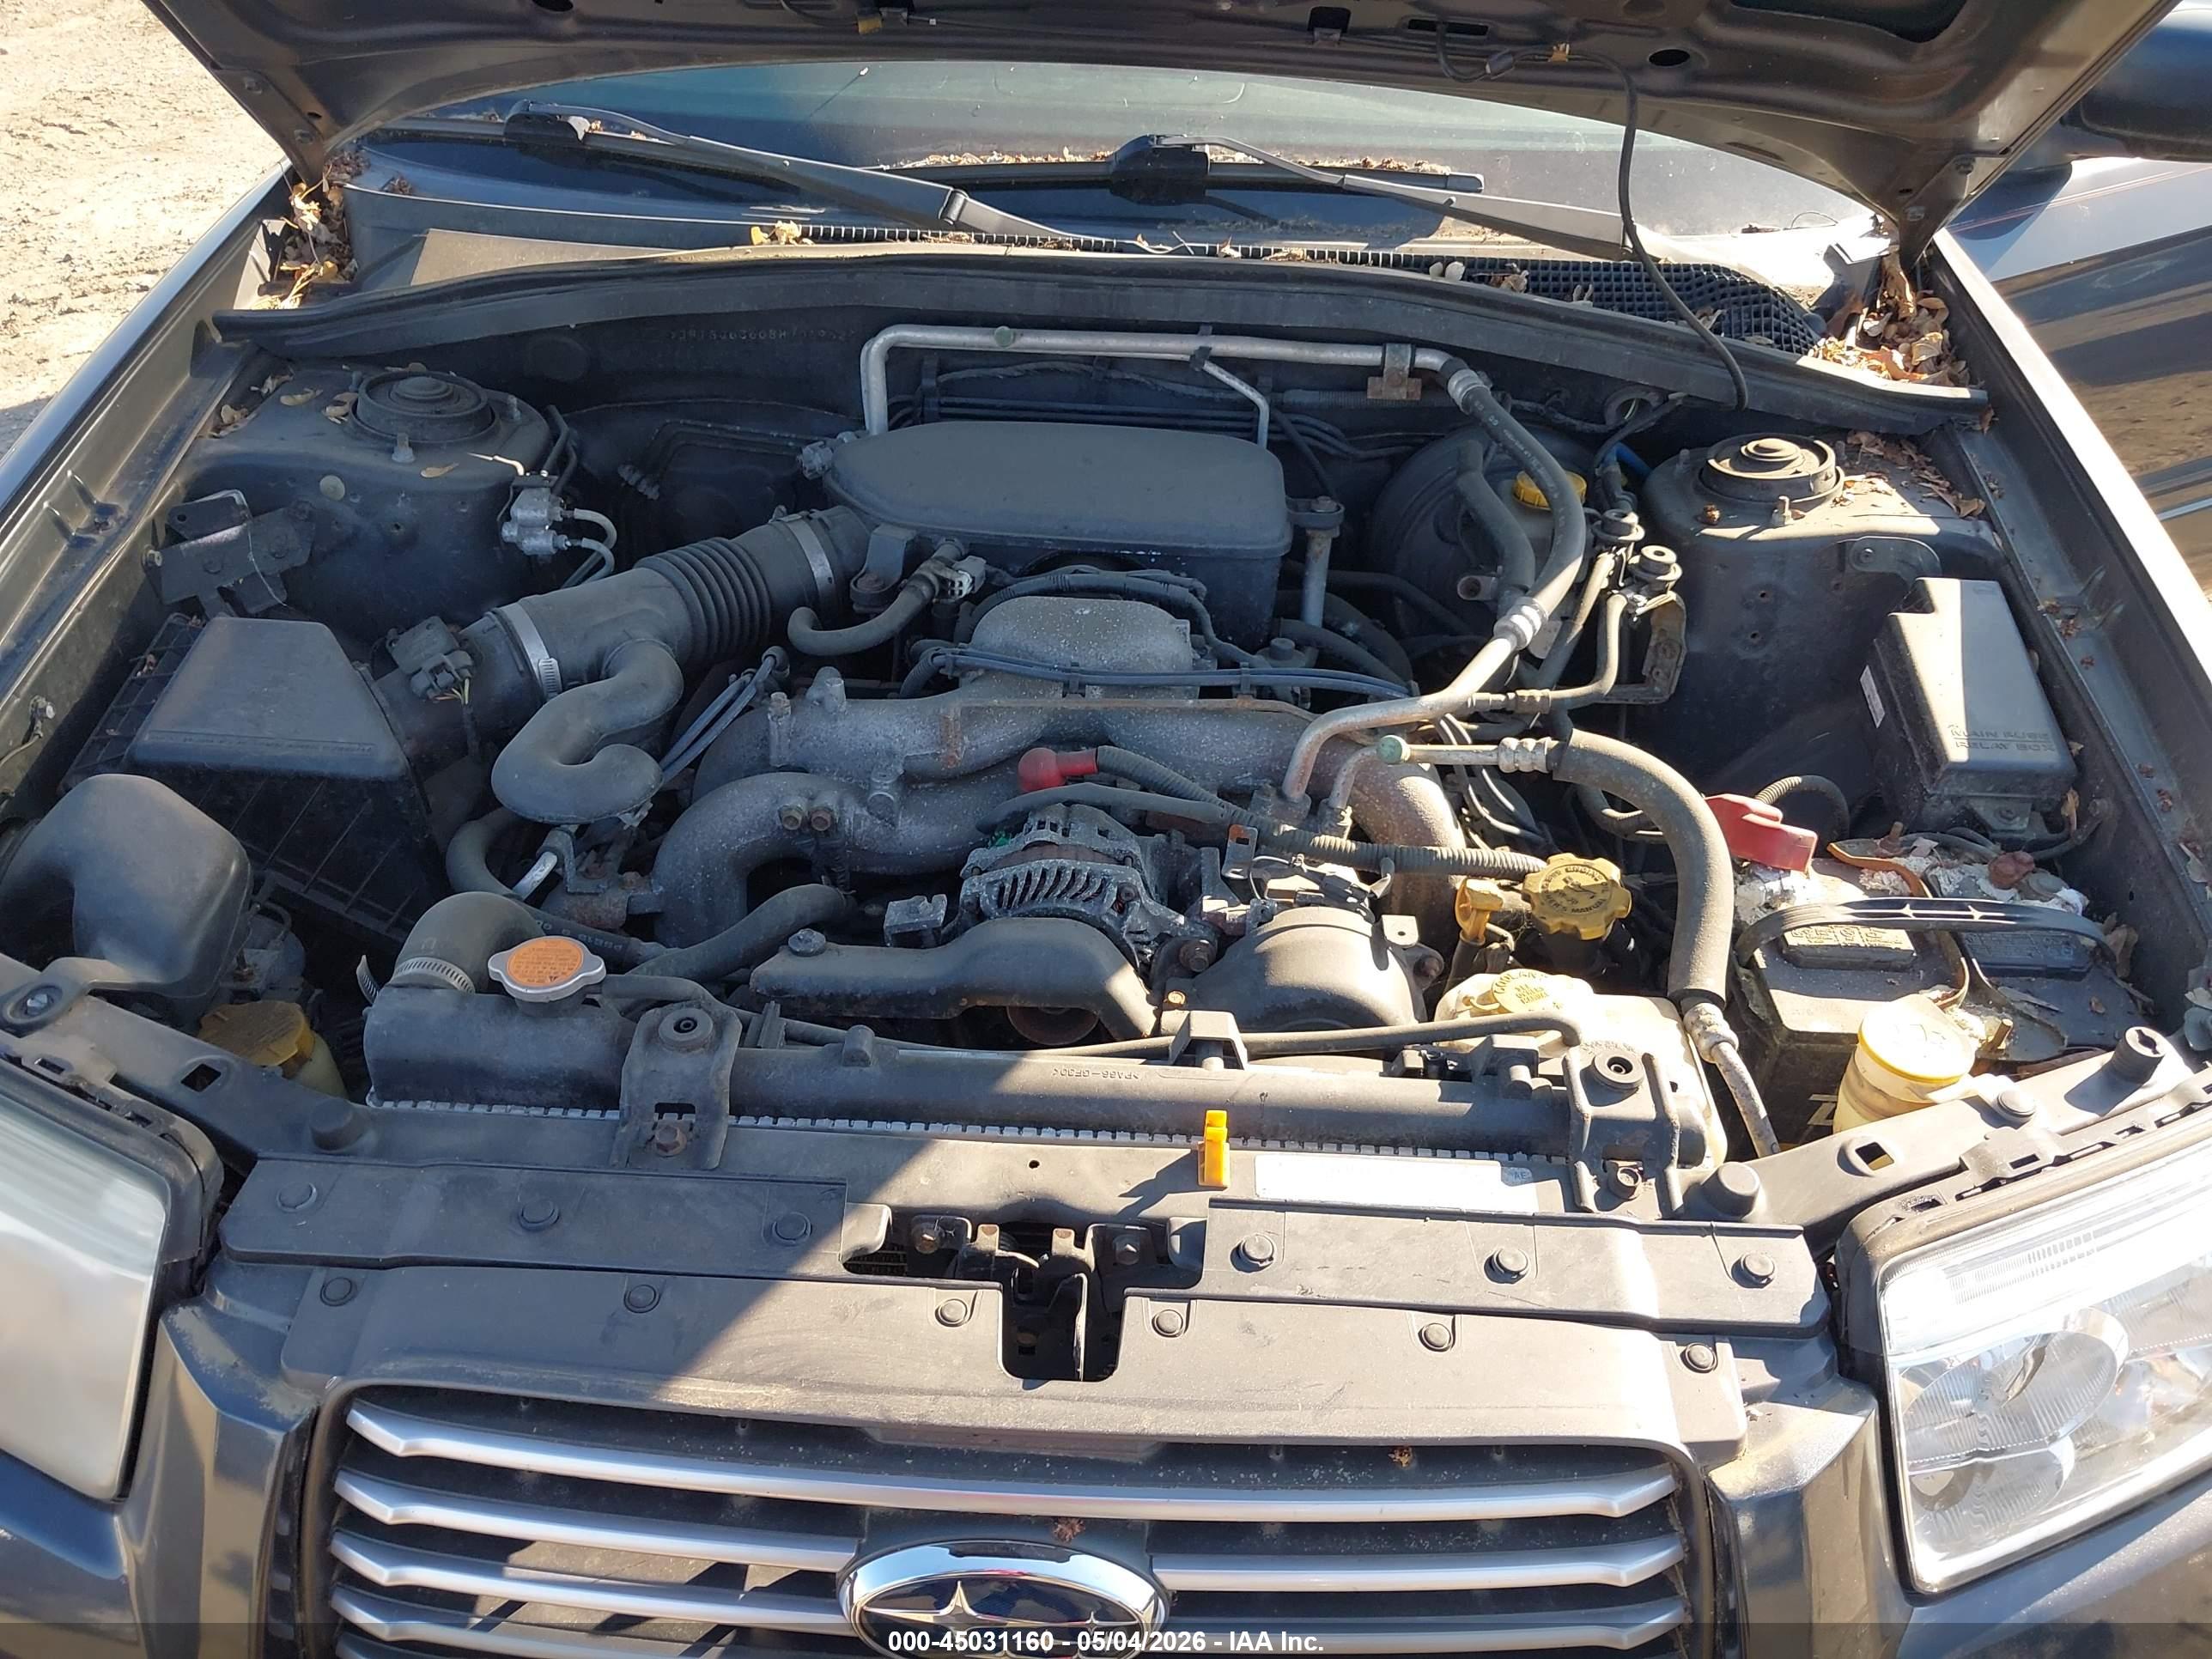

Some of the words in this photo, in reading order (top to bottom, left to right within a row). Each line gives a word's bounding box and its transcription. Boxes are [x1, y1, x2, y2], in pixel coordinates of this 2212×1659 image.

[1951, 728, 1997, 738] MAIN
[1955, 741, 2009, 750] RELAY
[2016, 744, 2055, 752] BOX
[1571, 898, 1607, 914] MANUAL
